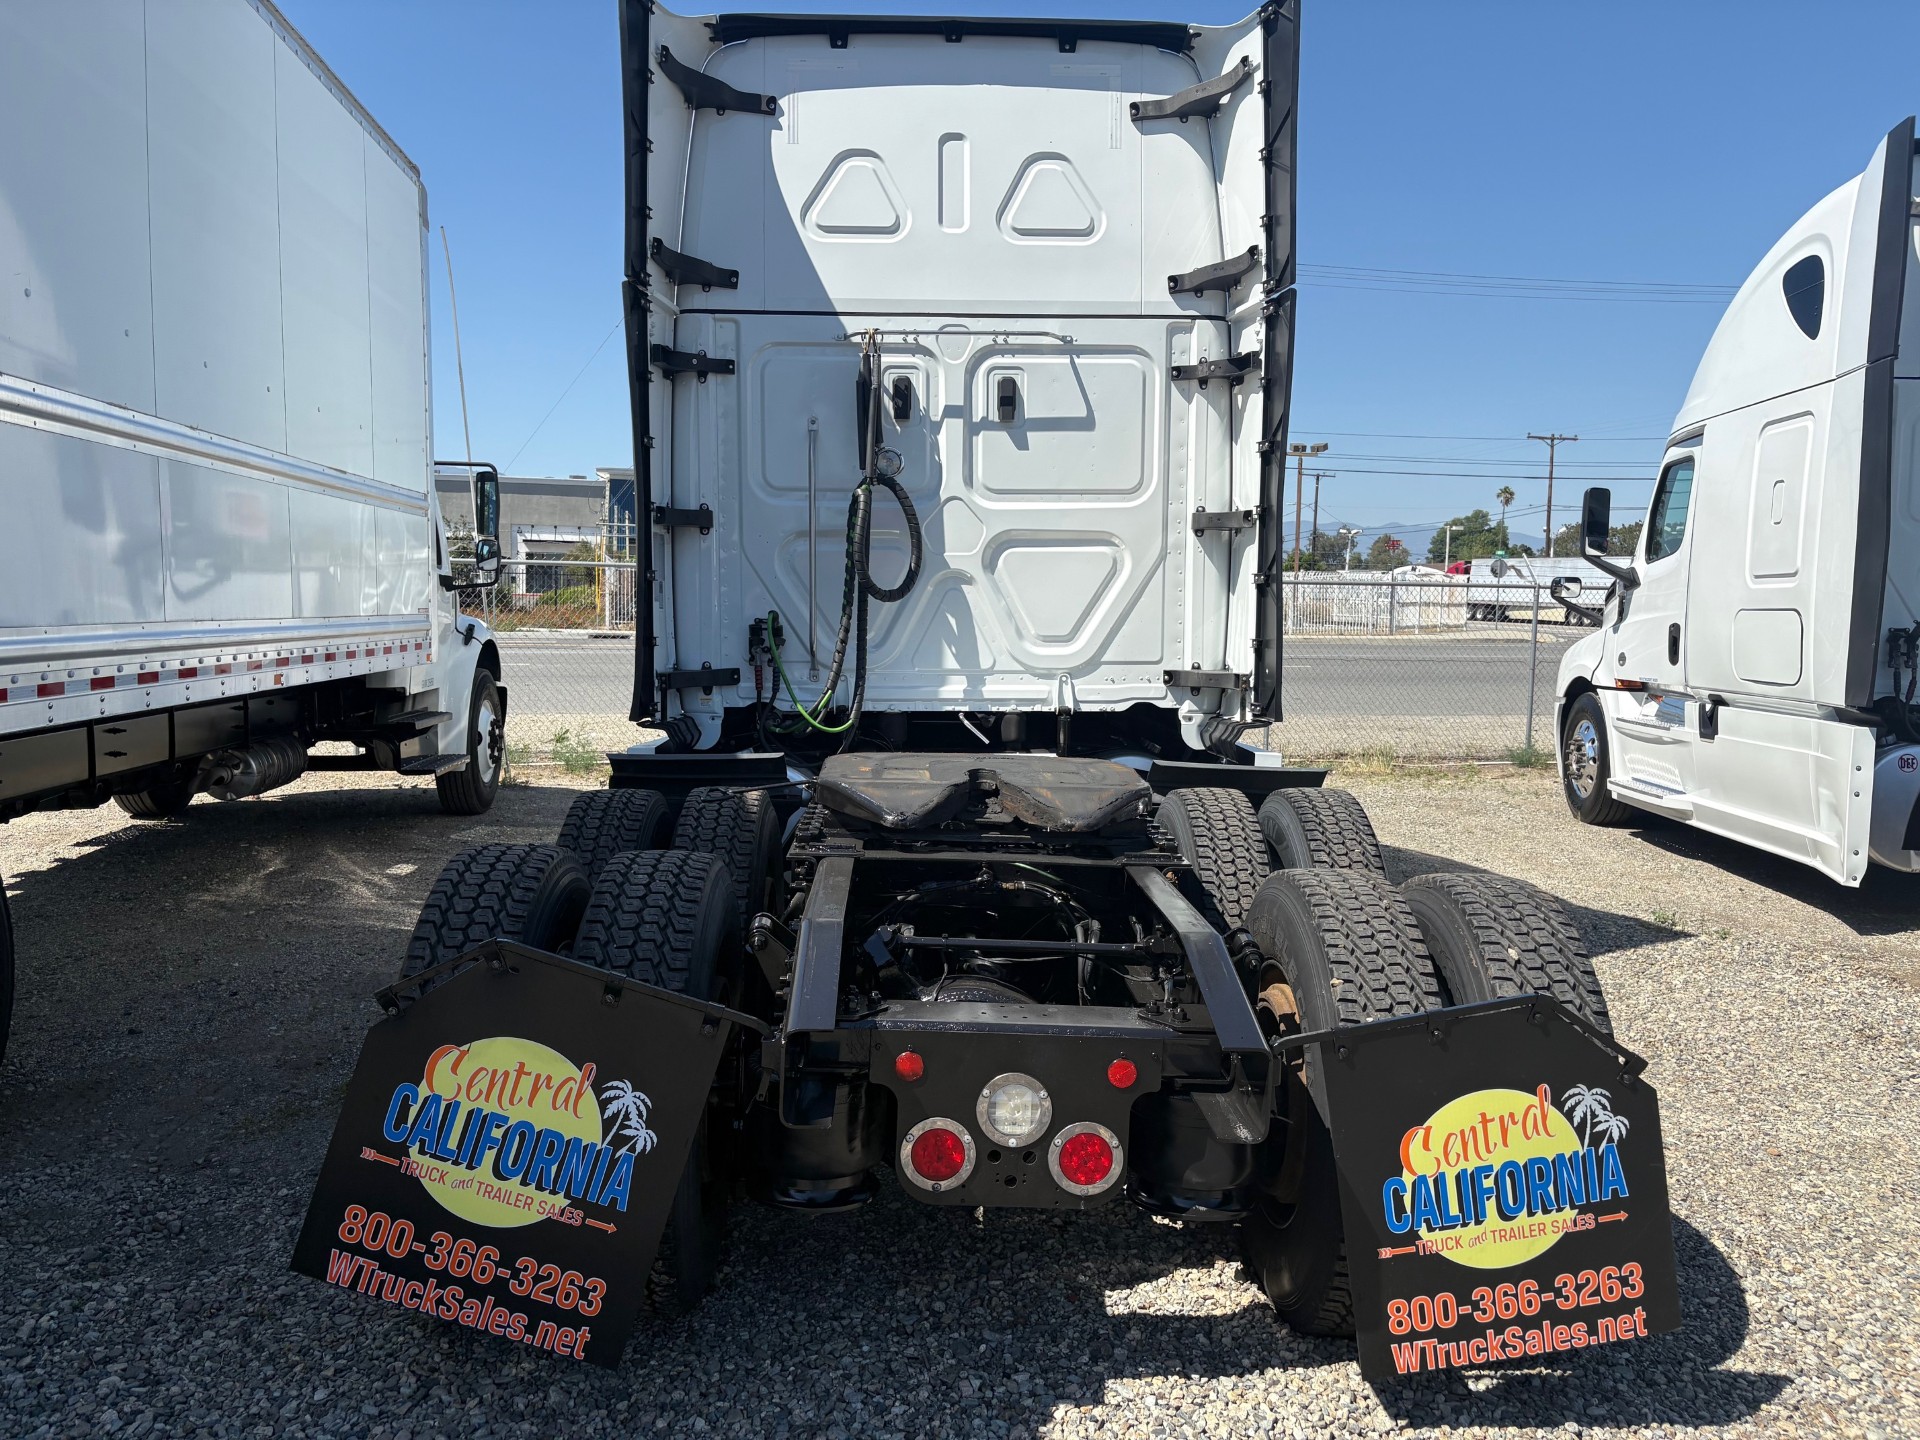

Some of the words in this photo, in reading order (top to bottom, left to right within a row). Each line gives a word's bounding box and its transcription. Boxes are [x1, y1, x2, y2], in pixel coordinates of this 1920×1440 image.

[1900, 757, 1916, 769] DEF
[424, 1044, 597, 1119] Central
[383, 1082, 636, 1213] CALIFORNIA
[1400, 1083, 1556, 1178] Central
[400, 1156, 448, 1186] TRUCK
[450, 1175, 474, 1191] and
[476, 1181, 534, 1212] TRAILER
[536, 1199, 584, 1227] SALES
[1382, 1143, 1629, 1234] CALIFORNIA
[338, 1204, 607, 1317] 800-366-3263
[1415, 1234, 1464, 1256] TRUCK
[1468, 1228, 1488, 1248] and
[1490, 1222, 1547, 1244] TRAILER
[1551, 1213, 1596, 1234] SALES
[326, 1248, 592, 1360] WTruckSales.net
[1387, 1262, 1645, 1335] 800-366-3263
[1390, 1306, 1648, 1374] WTruckSales.net
